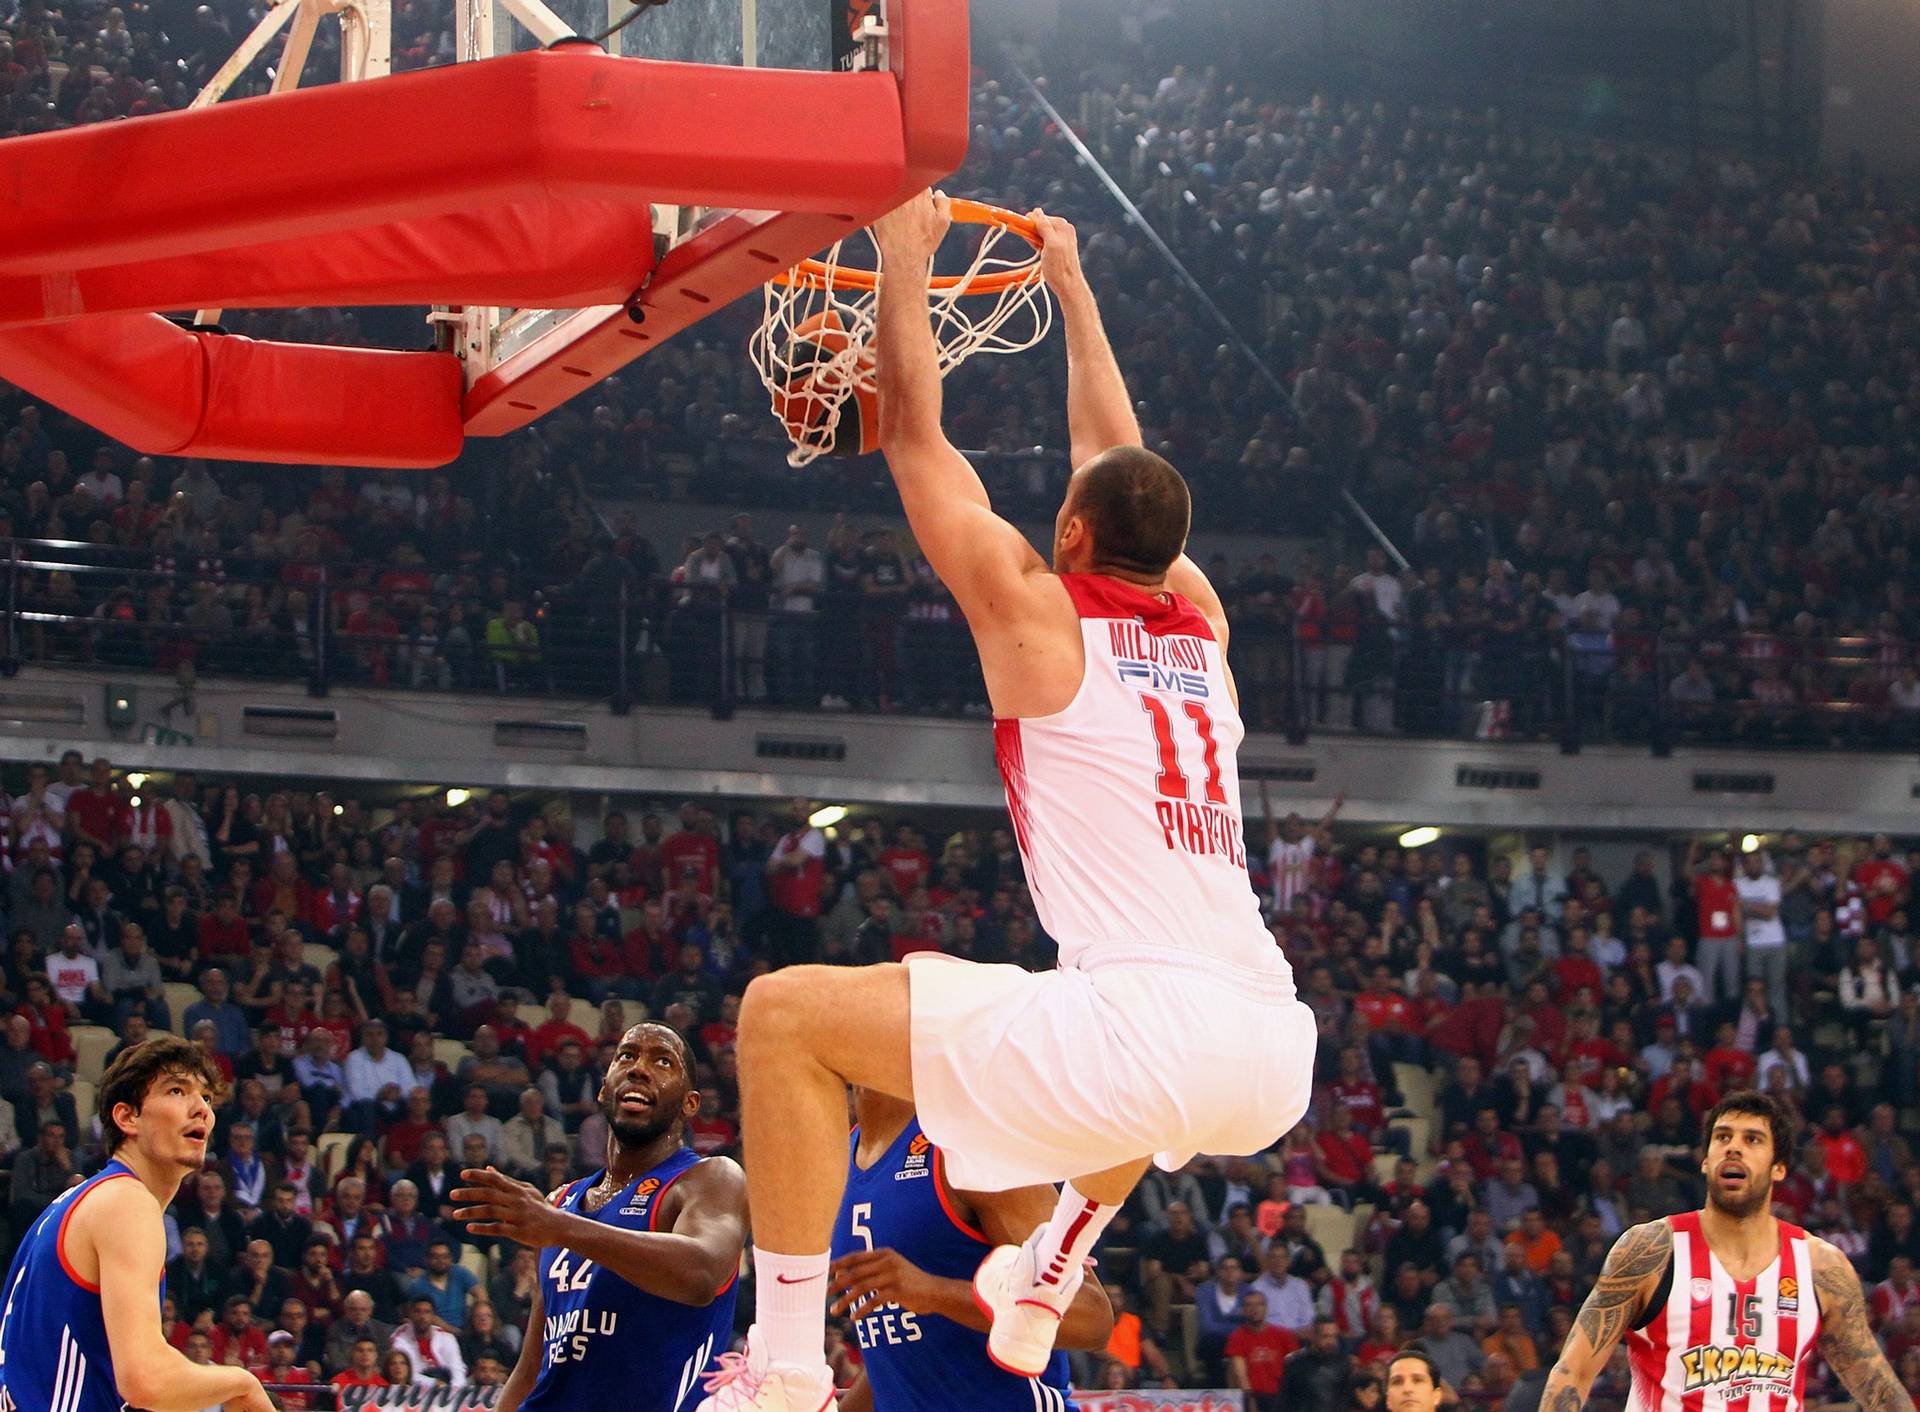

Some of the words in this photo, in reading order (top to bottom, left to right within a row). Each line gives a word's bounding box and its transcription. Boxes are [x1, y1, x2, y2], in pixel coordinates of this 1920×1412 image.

[1117, 660, 1210, 698] FMS
[1138, 691, 1229, 805] 11
[851, 1202, 873, 1252] 5
[855, 1311, 923, 1349] EFES
[1726, 1293, 1763, 1338] 15
